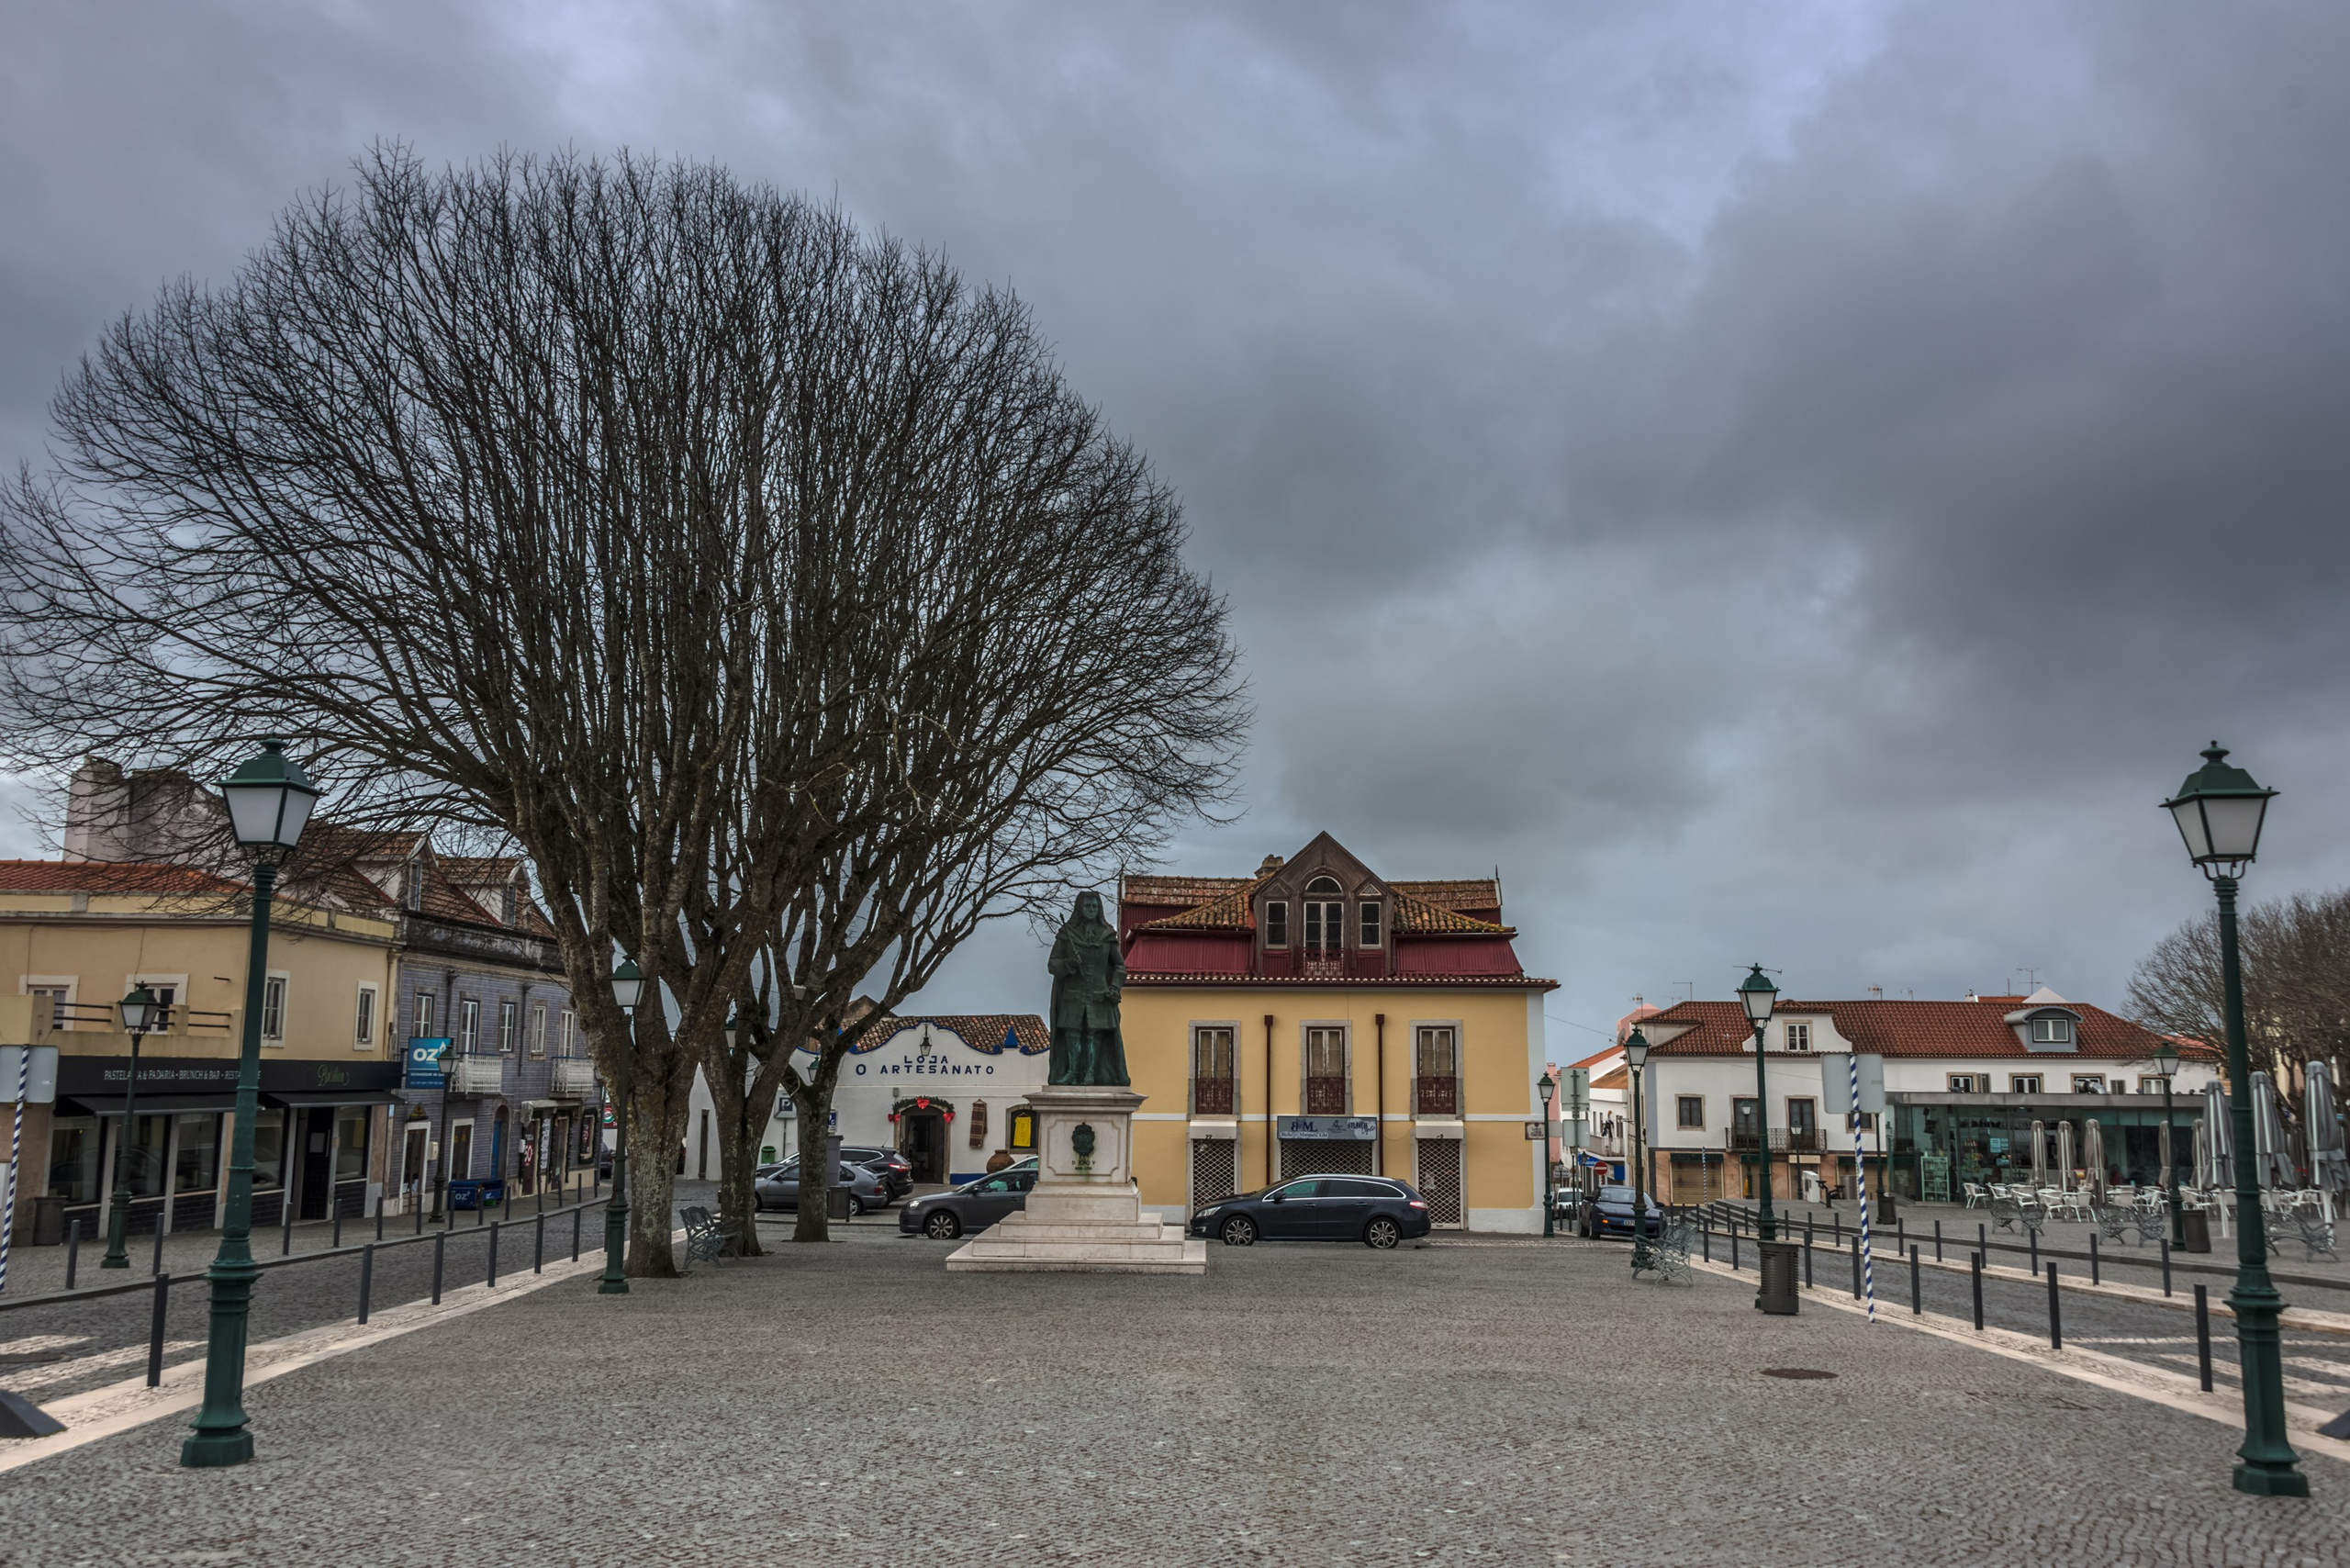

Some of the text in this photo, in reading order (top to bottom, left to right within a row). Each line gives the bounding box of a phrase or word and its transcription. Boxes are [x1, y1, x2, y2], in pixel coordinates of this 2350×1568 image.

[413, 1047, 439, 1061] OZ
[904, 1056, 948, 1064] LOJA
[148, 1070, 174, 1080] PADARIA
[856, 1064, 994, 1075] O ARTESANATO
[782, 1099, 790, 1111] P
